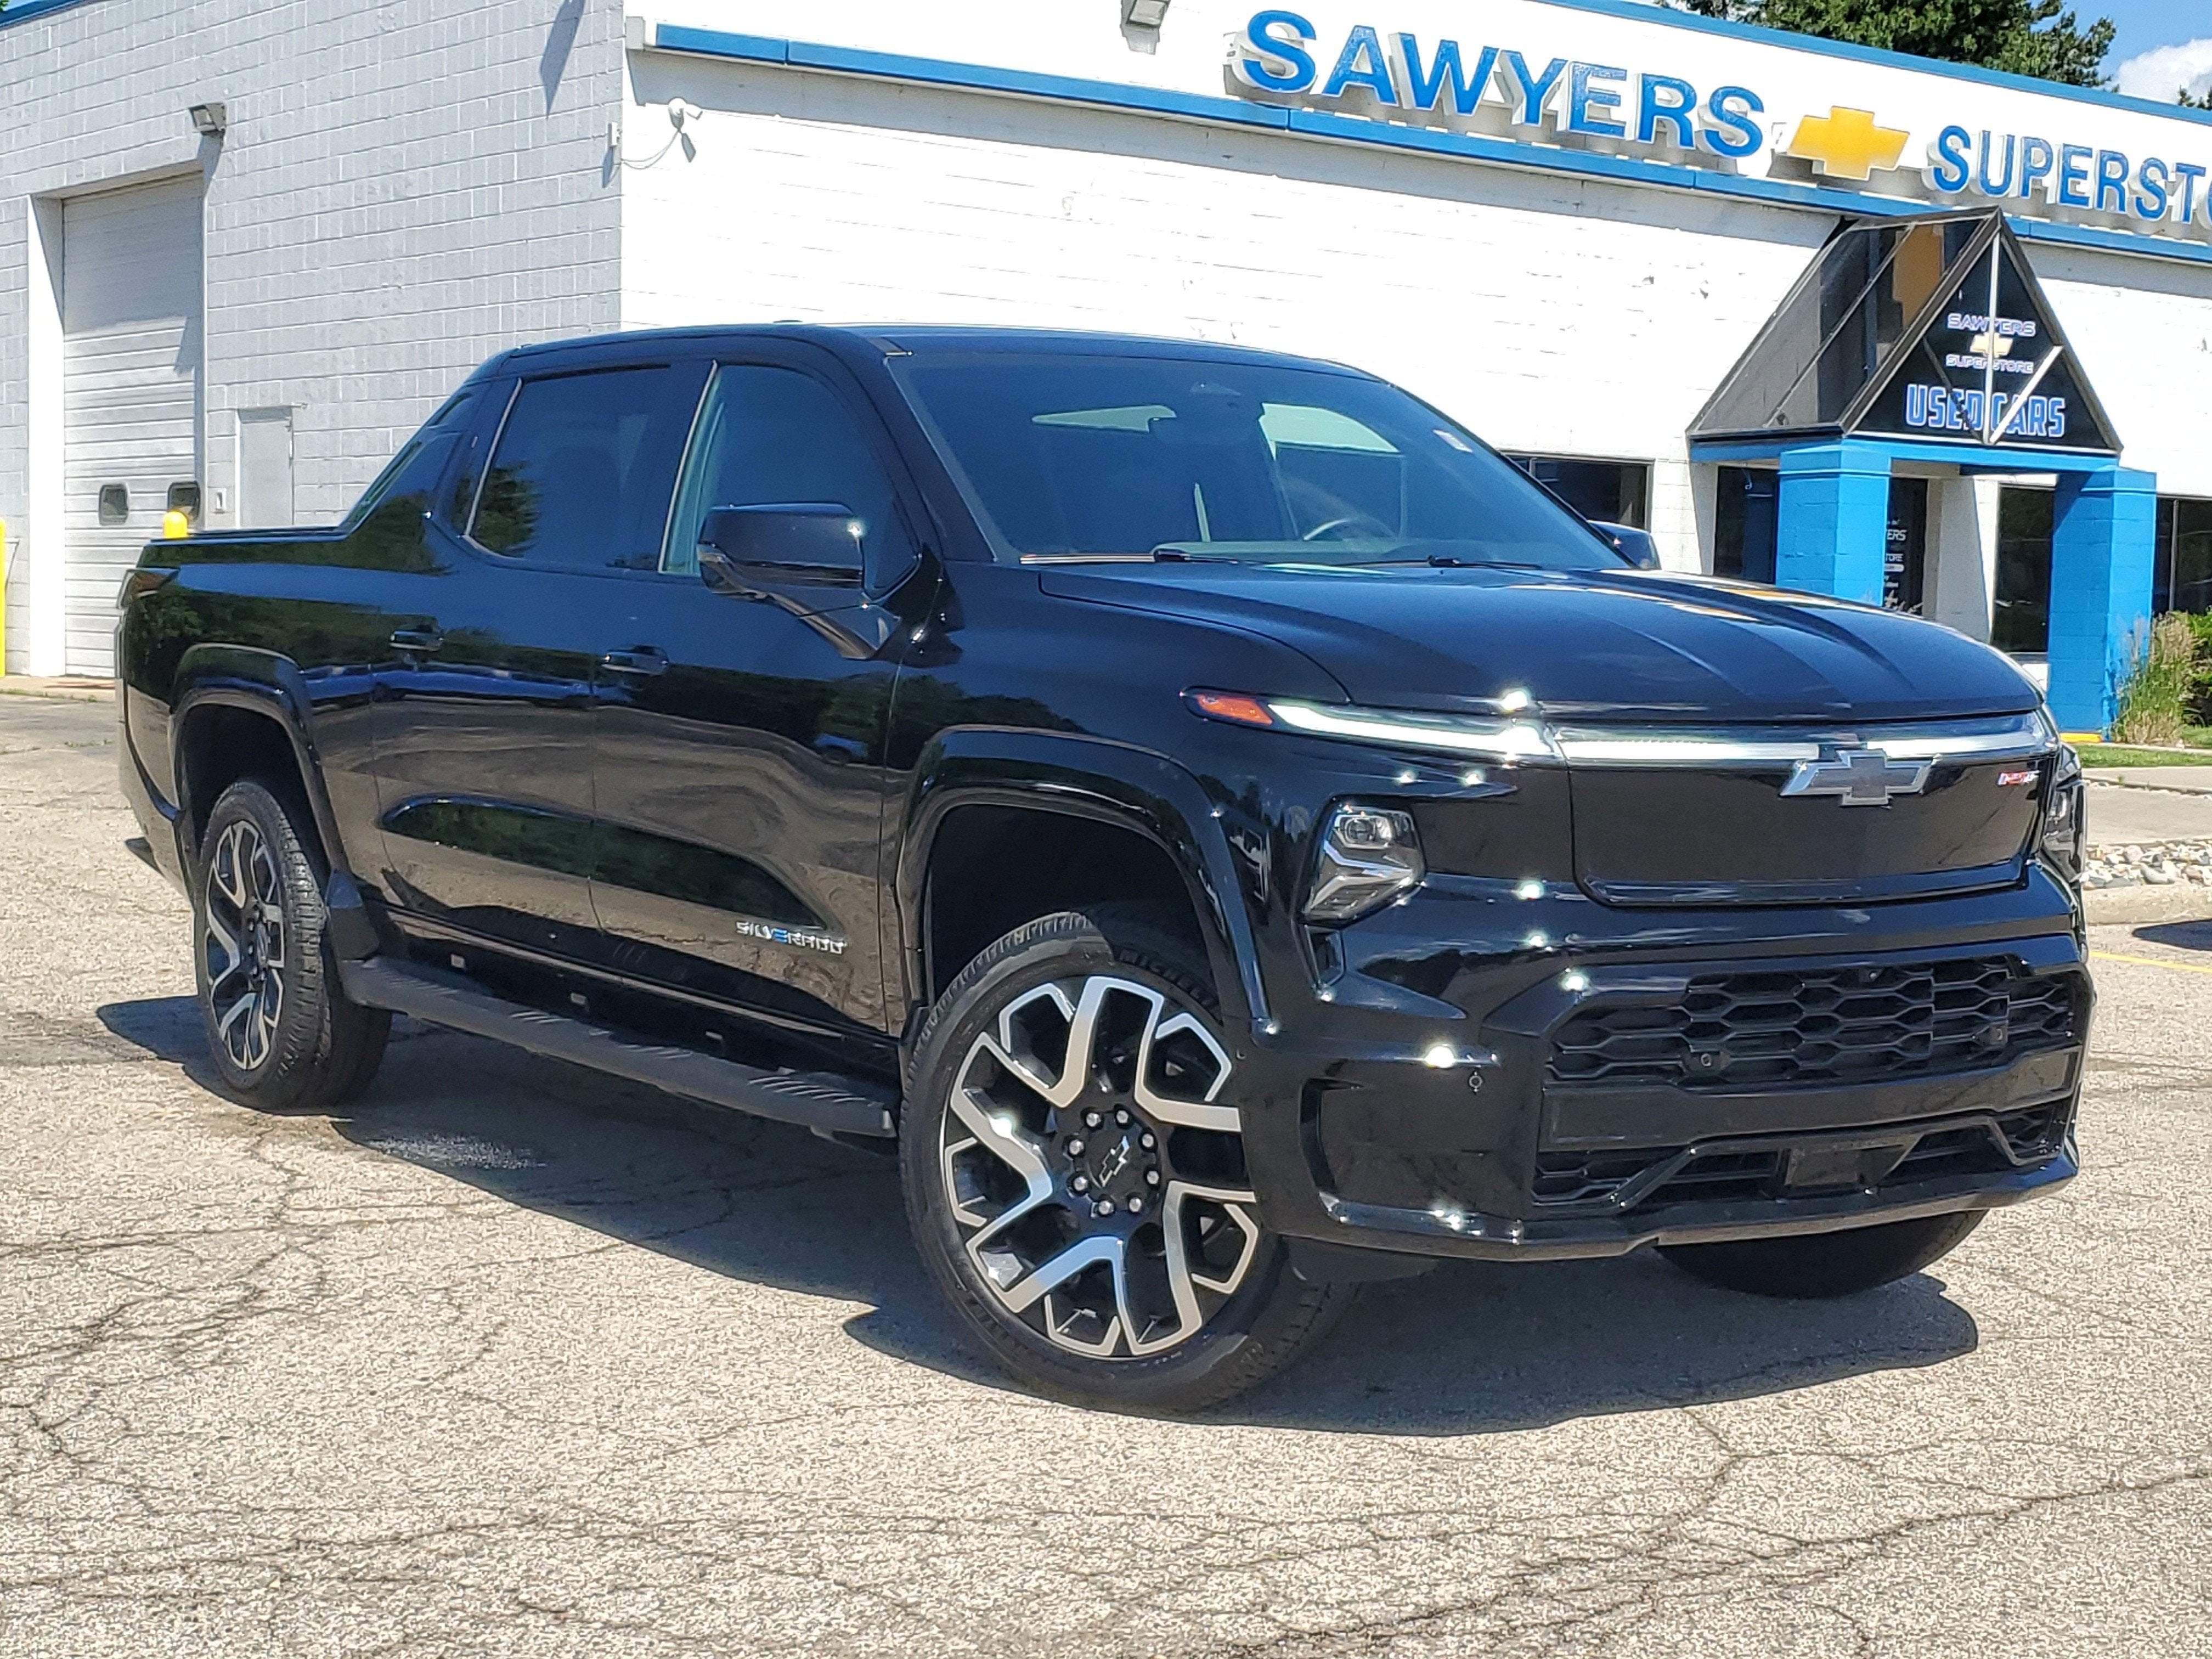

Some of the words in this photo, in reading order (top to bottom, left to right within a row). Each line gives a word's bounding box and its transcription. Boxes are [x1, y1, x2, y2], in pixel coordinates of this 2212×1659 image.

[1242, 10, 1764, 158] SAWYERS
[1933, 125, 2212, 229] SUPERST
[1906, 384, 1985, 431] USED
[736, 921, 848, 954] SILVERADO
